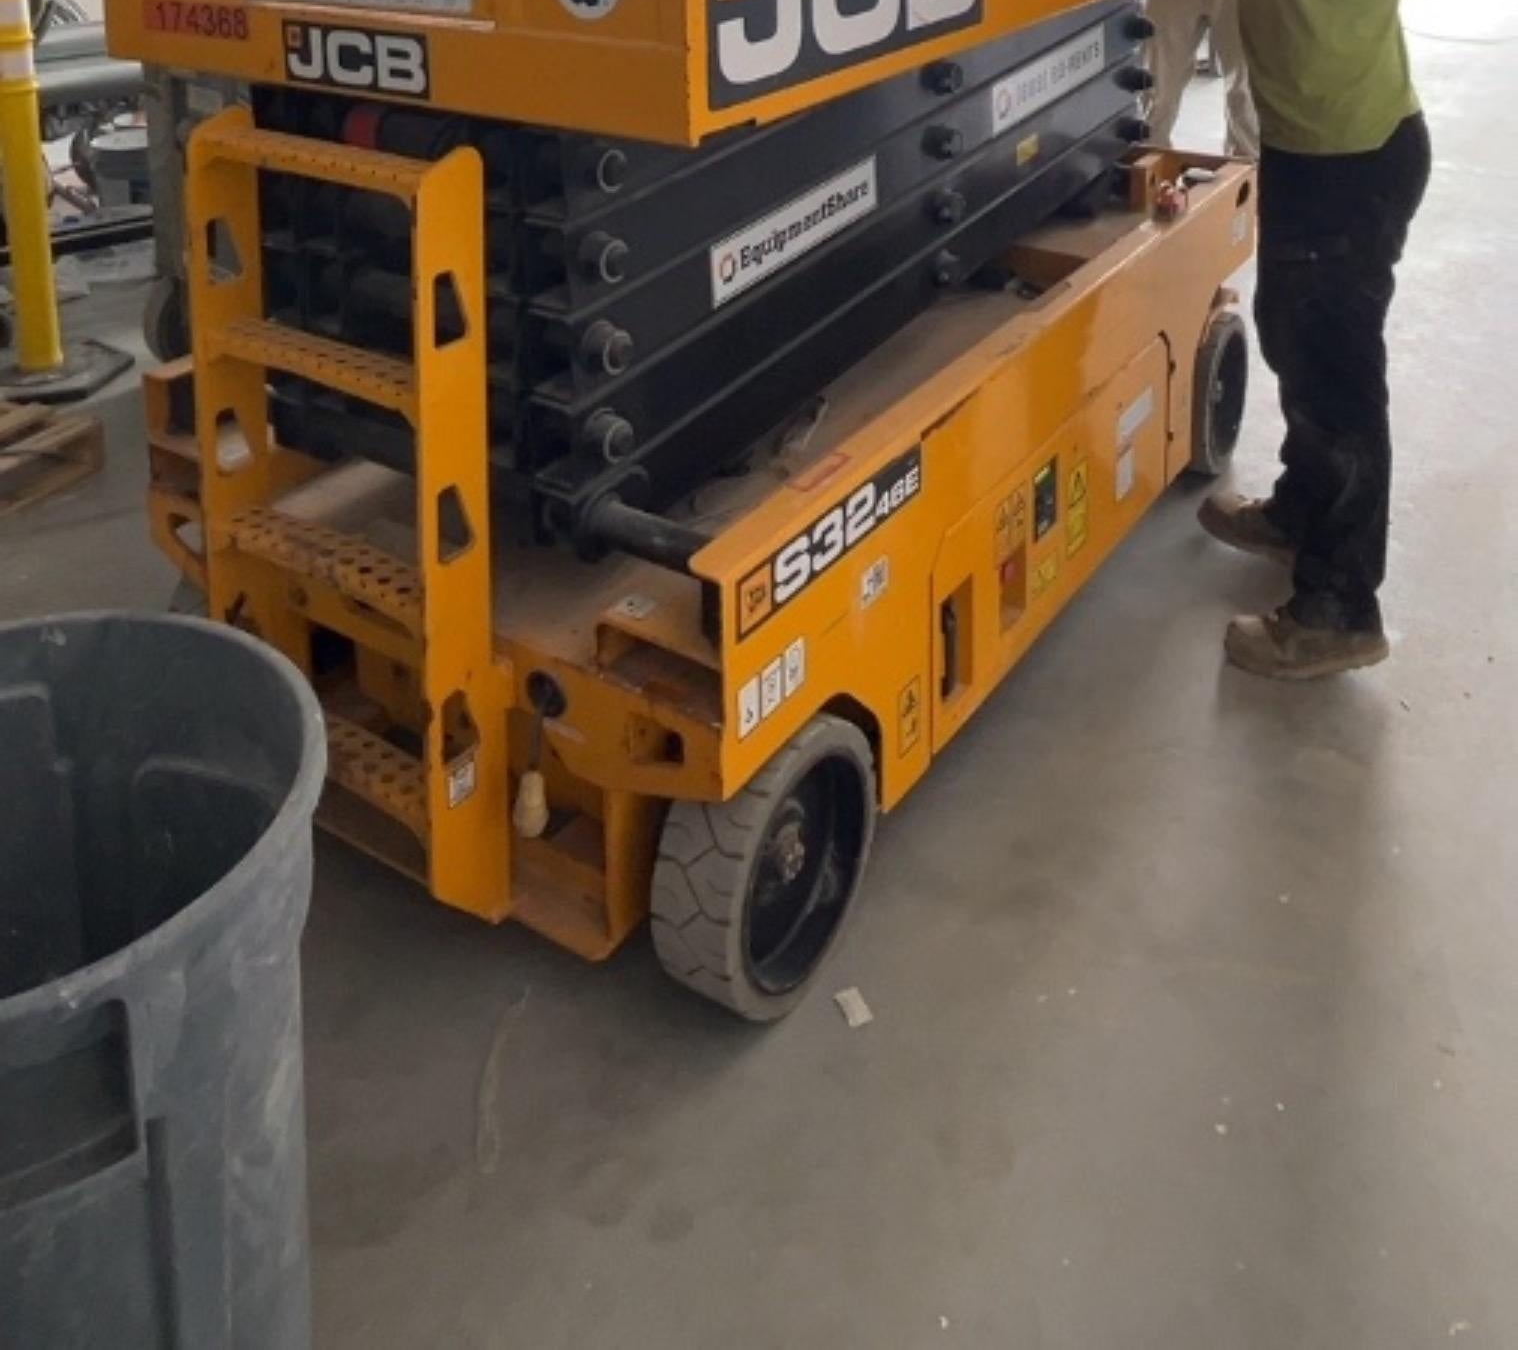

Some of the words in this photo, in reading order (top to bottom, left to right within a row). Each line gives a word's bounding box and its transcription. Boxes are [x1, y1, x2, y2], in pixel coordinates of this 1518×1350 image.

[156, 1, 249, 40] 174368
[288, 27, 427, 94] JCB
[741, 181, 868, 269] EquipmentShare
